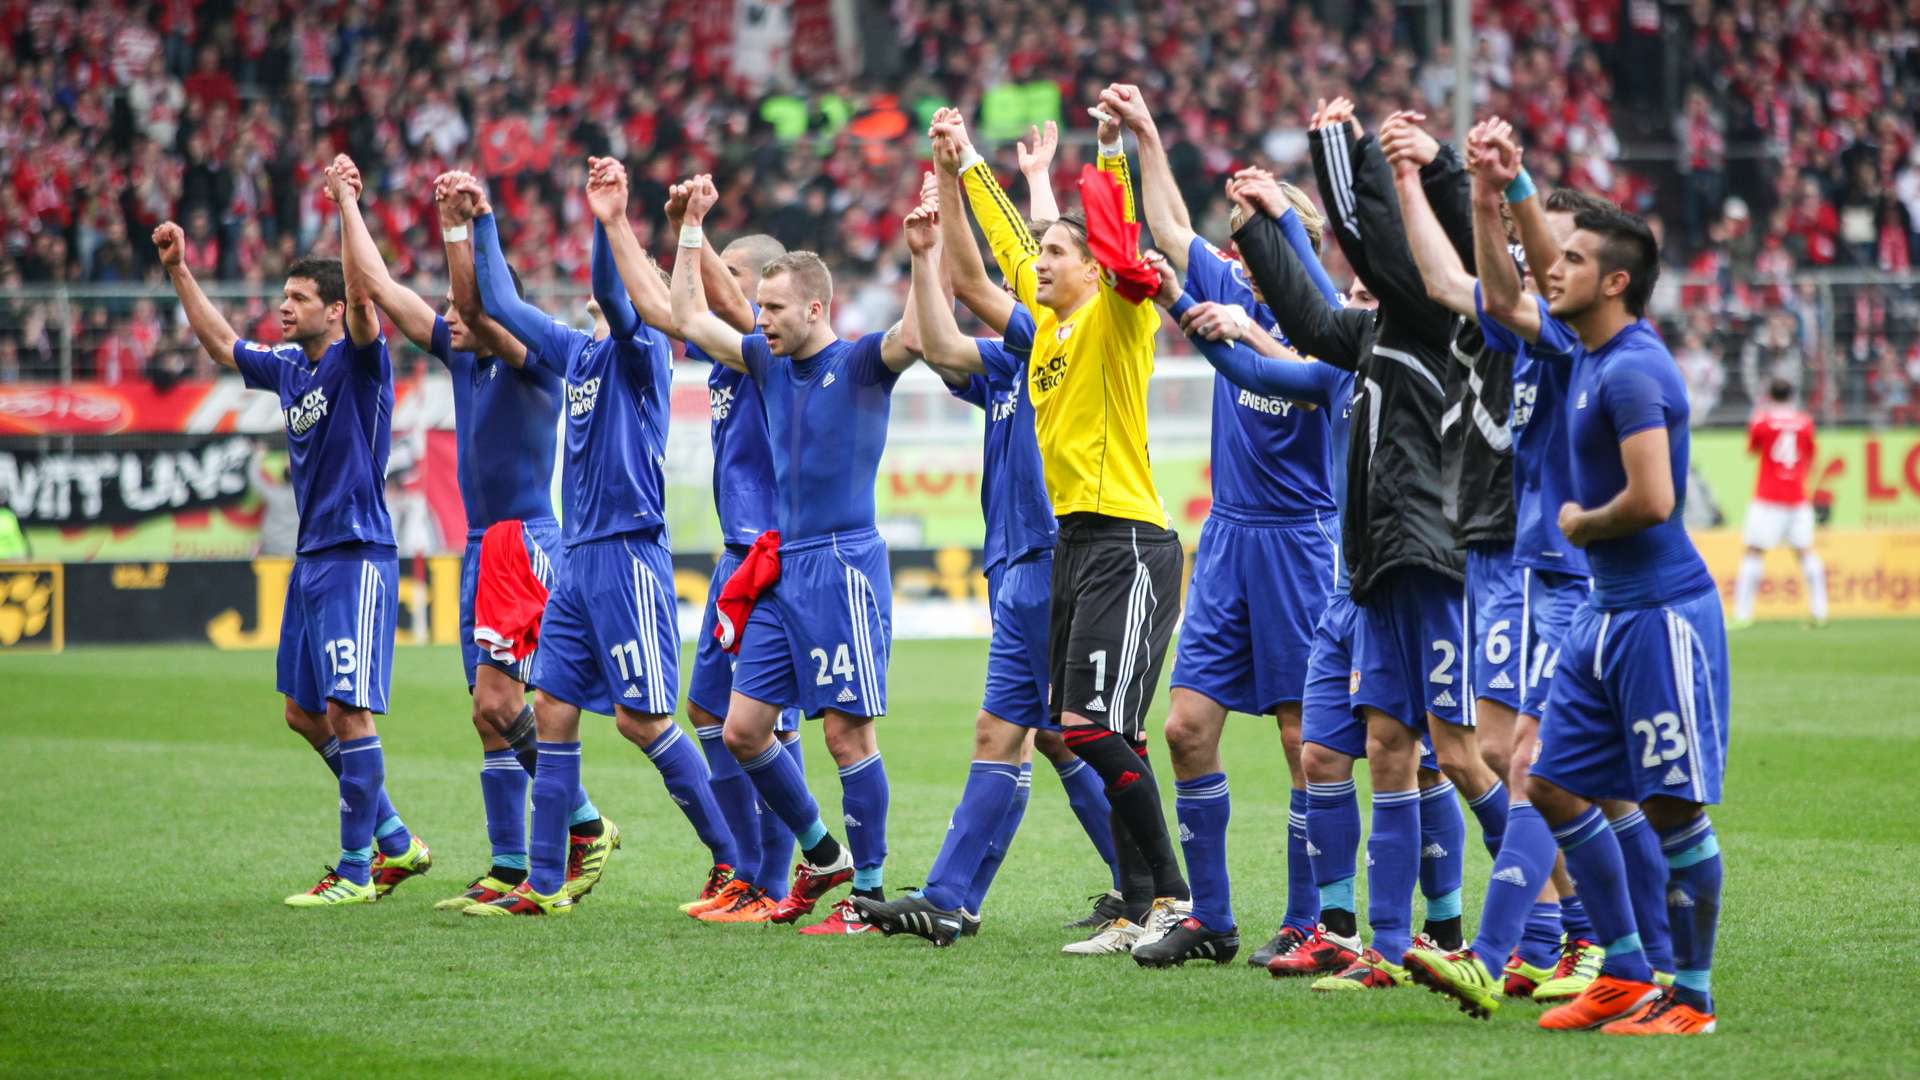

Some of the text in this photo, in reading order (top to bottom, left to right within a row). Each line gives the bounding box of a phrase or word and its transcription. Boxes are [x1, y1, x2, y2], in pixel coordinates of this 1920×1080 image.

[1238, 388, 1294, 418] ENERGY
[1769, 430, 1799, 470] 4
[1822, 563, 1920, 611] Erdg
[325, 637, 358, 676] 13
[610, 639, 644, 681] 11
[1429, 639, 1456, 685] 2
[1485, 619, 1511, 665] 6
[810, 643, 855, 686] 24
[1088, 649, 1107, 692] 1
[1632, 711, 1688, 768] 23
